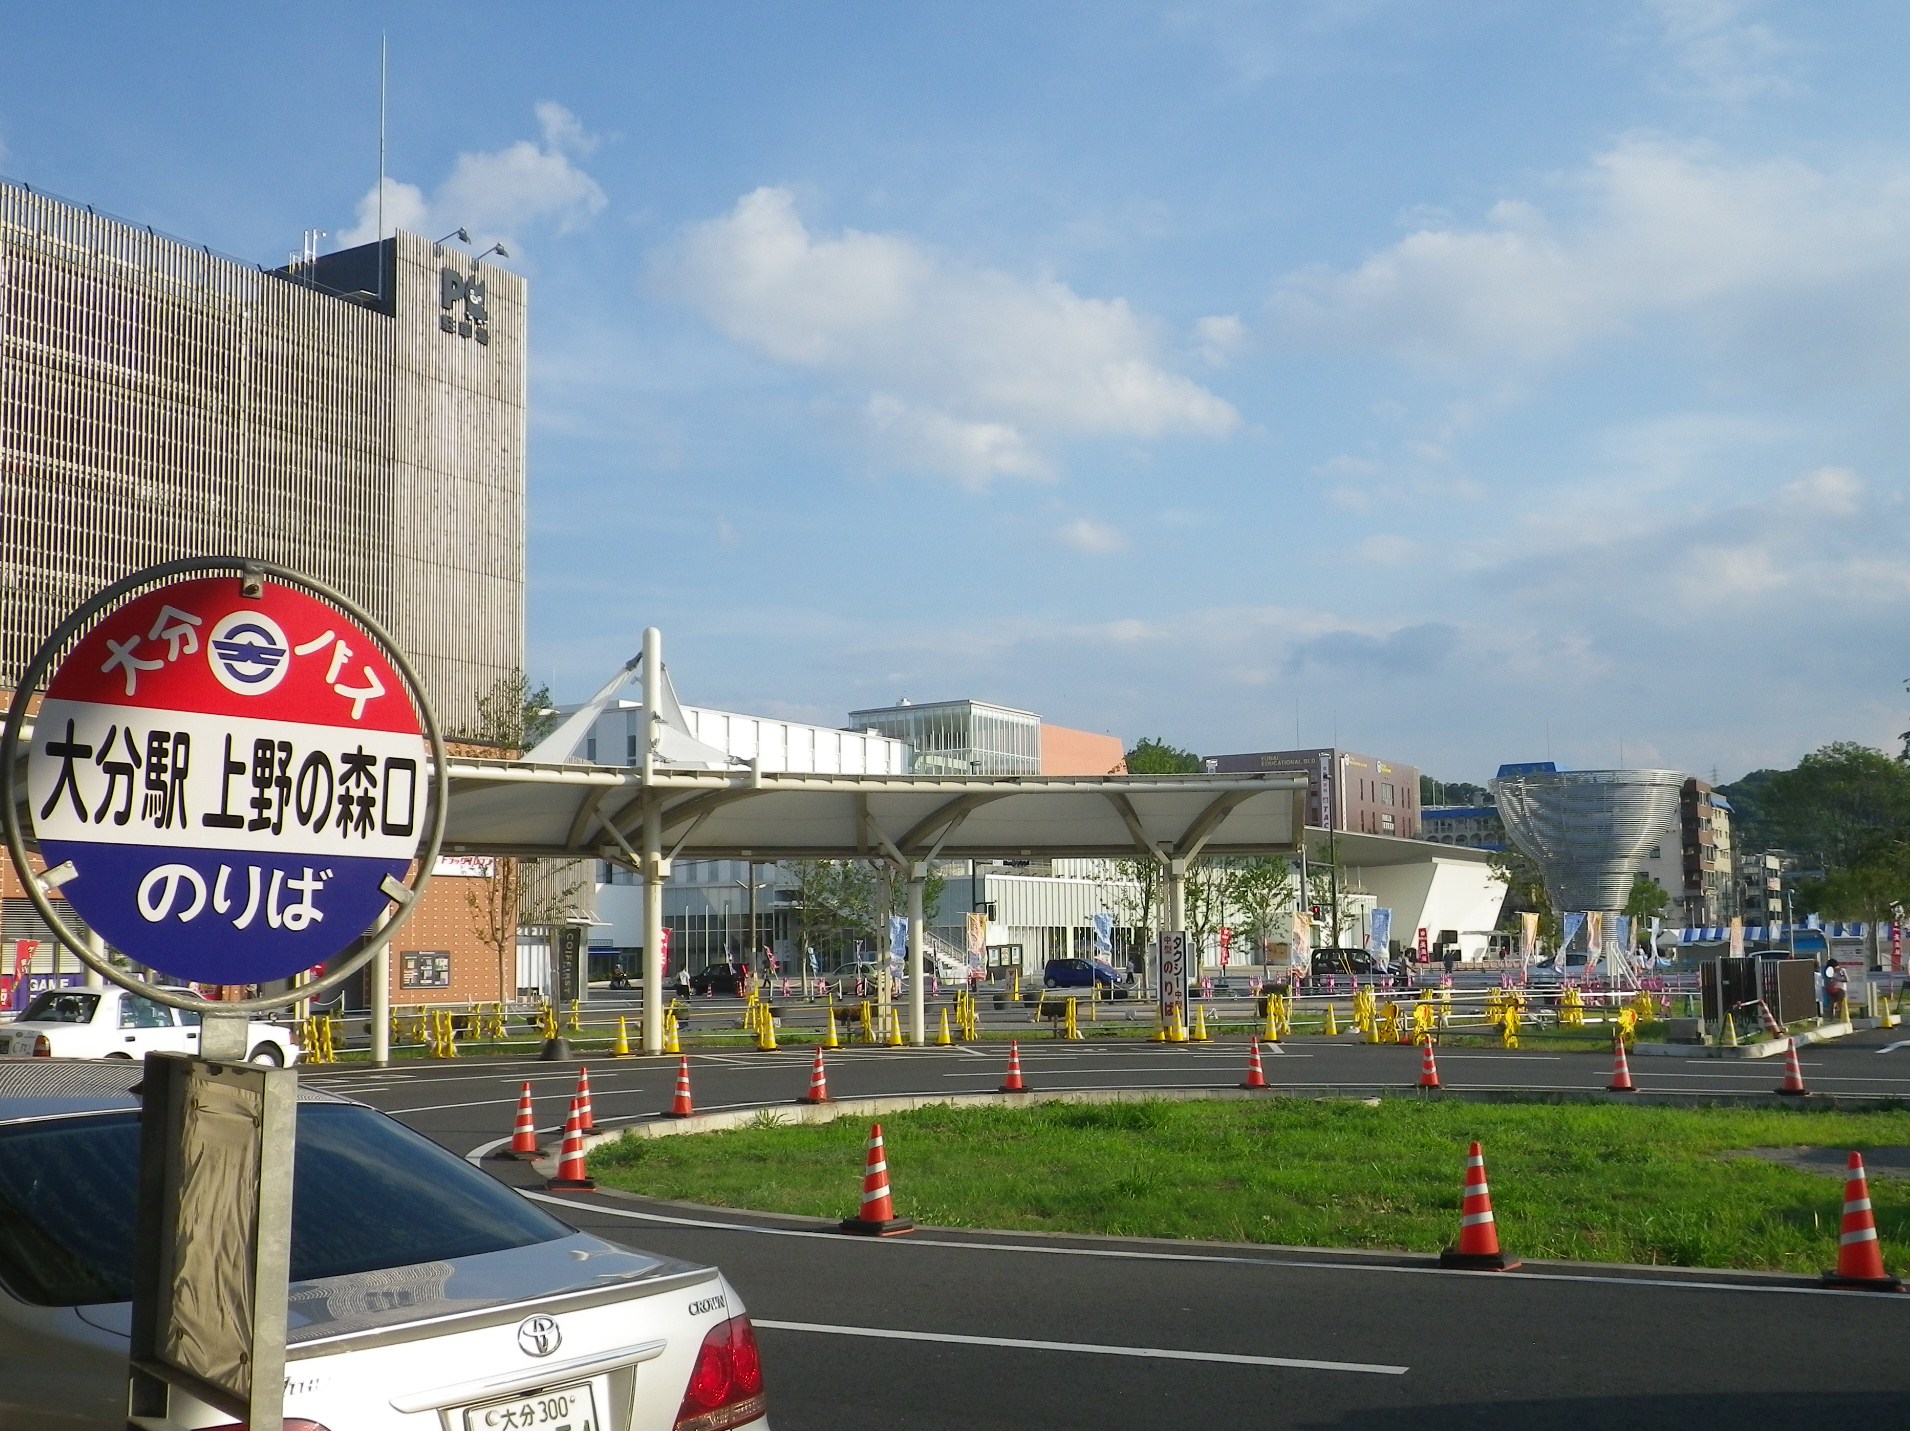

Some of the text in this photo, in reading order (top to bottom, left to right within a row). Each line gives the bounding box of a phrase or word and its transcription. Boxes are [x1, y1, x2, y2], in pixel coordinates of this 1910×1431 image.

[101, 604, 386, 721] 大分 バス
[41, 718, 418, 841] 大分駅 上野の森口
[136, 863, 334, 932] のりば
[688, 1295, 726, 1316] CROWN
[500, 1404, 536, 1431] 大分
[537, 1395, 569, 1423] 300
